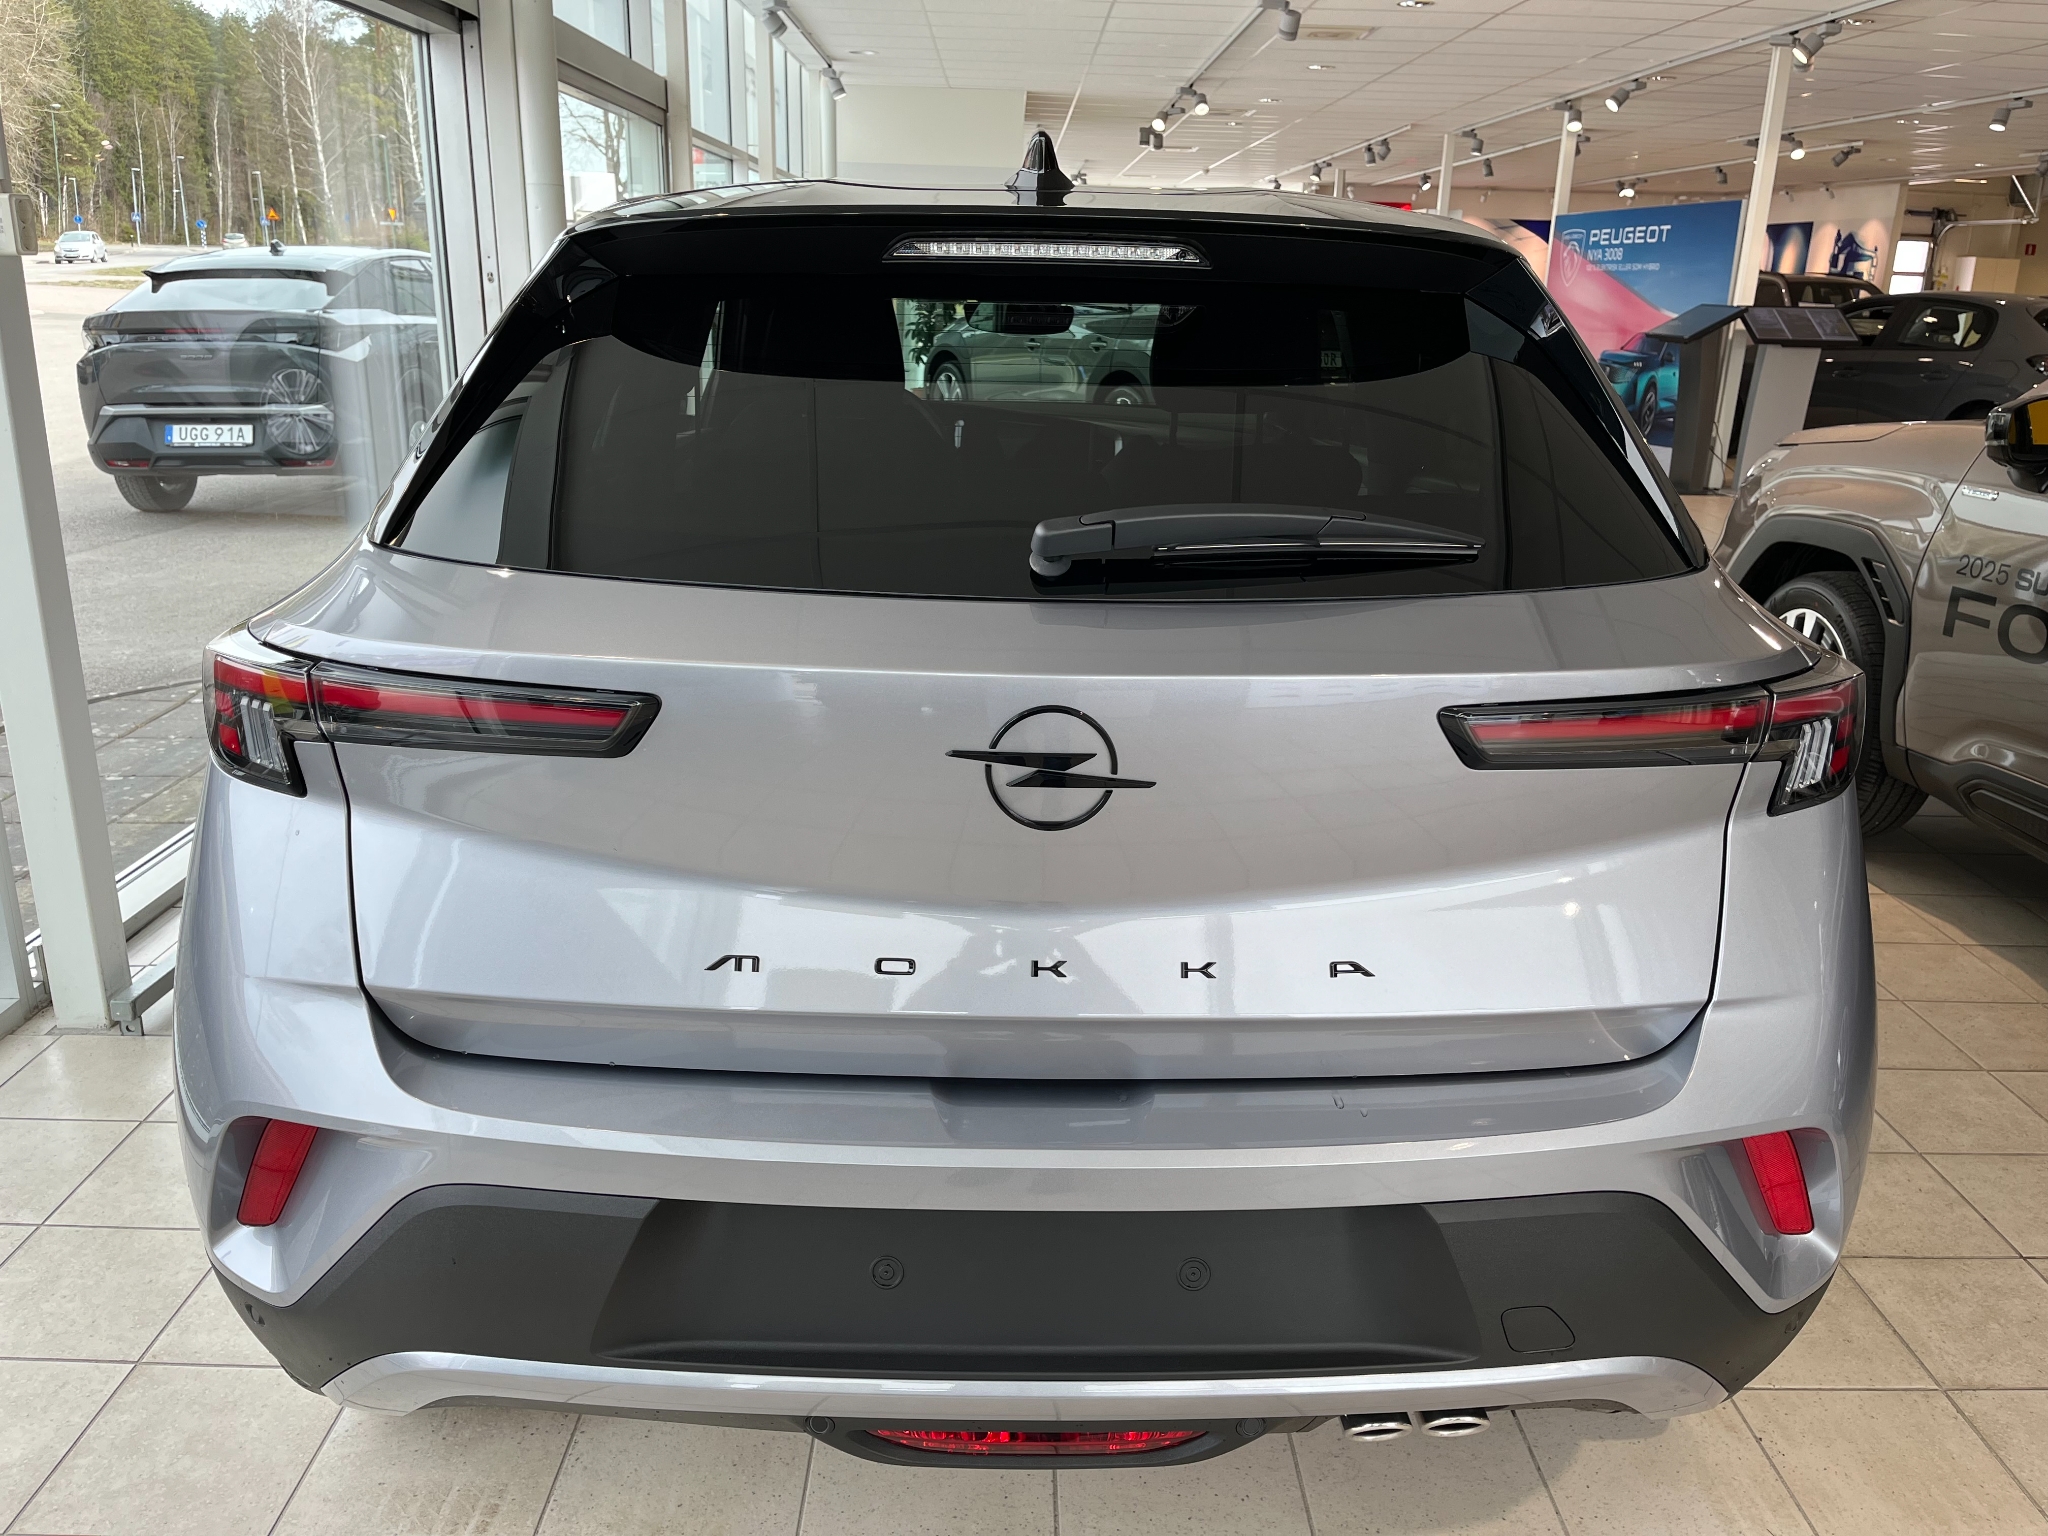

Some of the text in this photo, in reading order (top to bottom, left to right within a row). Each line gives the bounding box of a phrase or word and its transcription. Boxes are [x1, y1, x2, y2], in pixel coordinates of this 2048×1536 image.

[1589, 225, 1672, 245] PEUGEOT
[1586, 247, 1624, 261] NYA 3008
[178, 427, 245, 441] UGG 91A
[1956, 554, 2012, 586] 2025
[1942, 586, 2048, 664] FO
[704, 954, 1376, 978] MOKKA
